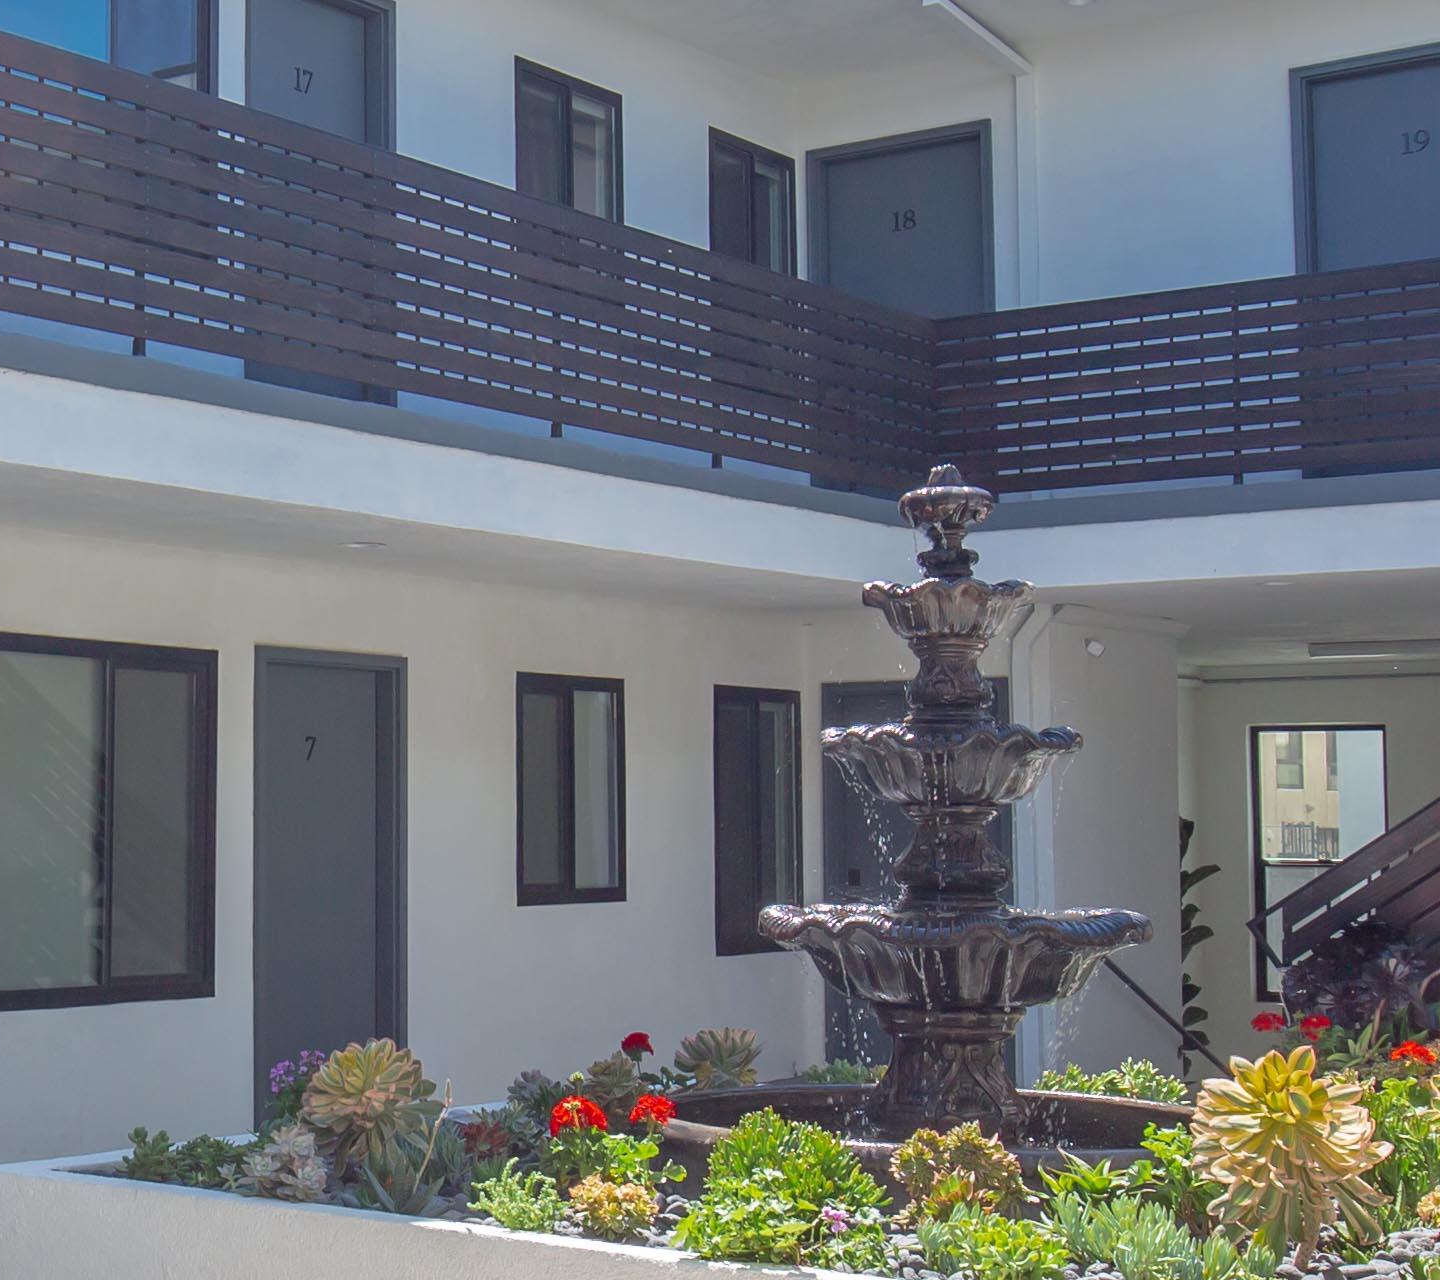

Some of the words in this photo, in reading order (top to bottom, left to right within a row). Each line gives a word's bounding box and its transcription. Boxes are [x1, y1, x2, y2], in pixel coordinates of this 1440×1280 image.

[293, 66, 314, 94] 17
[1401, 129, 1431, 155] 19
[891, 208, 917, 232] 18
[304, 736, 317, 761] 7
